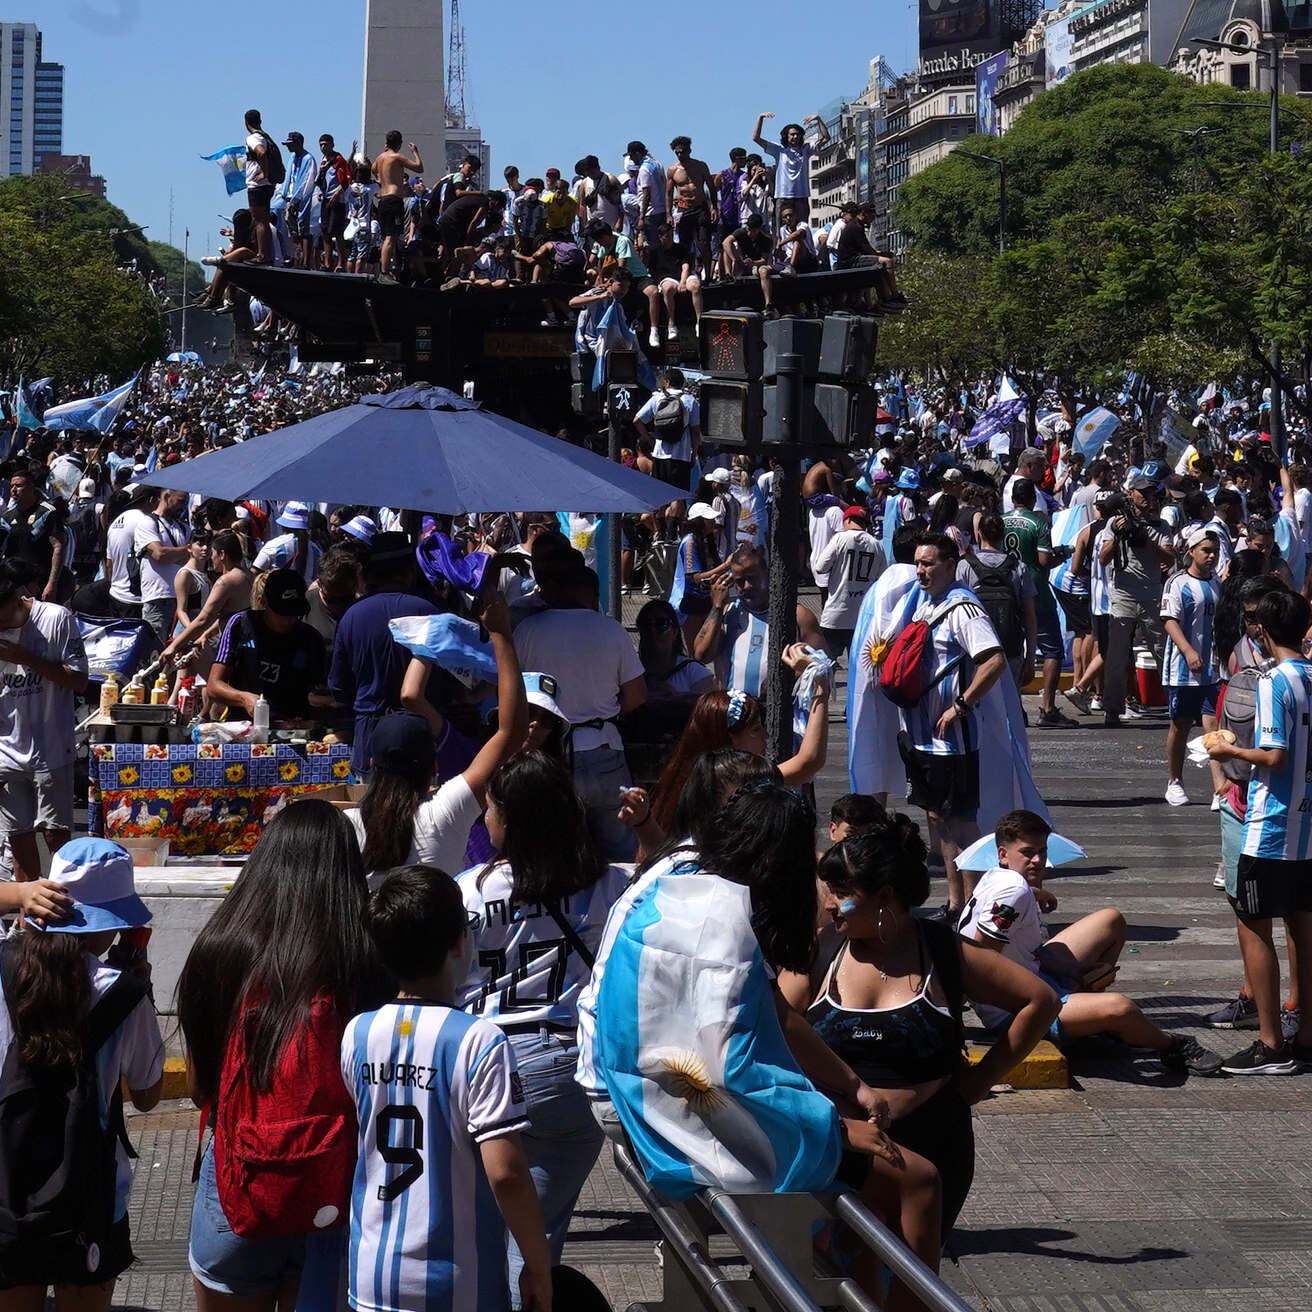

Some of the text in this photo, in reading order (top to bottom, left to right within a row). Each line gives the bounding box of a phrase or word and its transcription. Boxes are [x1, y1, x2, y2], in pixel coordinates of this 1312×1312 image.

[848, 549, 875, 583] 10
[259, 661, 281, 683] 23
[472, 937, 569, 1015] 10
[361, 1063, 438, 1091] ALVAREZ
[376, 1105, 424, 1201] 9
